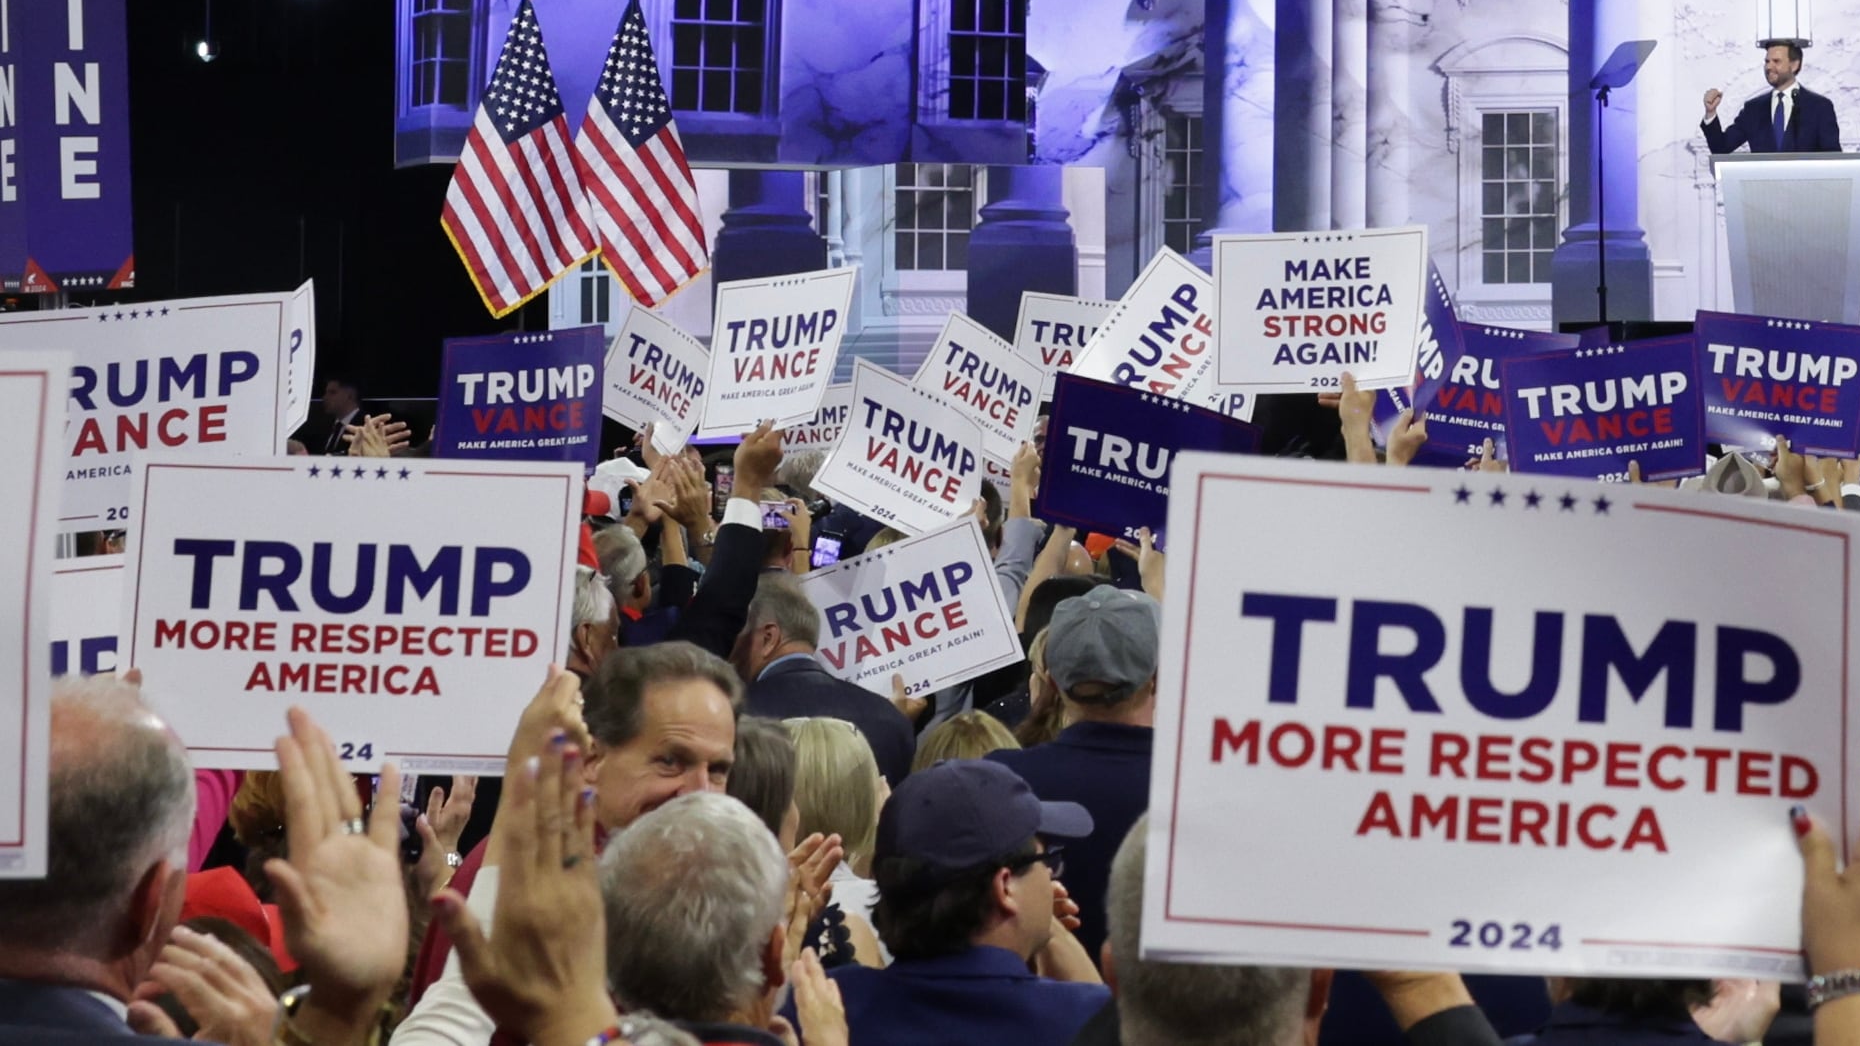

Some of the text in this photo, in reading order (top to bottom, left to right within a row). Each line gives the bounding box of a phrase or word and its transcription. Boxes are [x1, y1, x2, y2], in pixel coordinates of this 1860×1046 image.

[1285, 257, 1370, 282] MAKE
[1256, 284, 1392, 310] AMERICA
[727, 309, 837, 353] TRUMP
[1031, 320, 1098, 347] TRU
[1112, 283, 1198, 388] RUMP
[1263, 312, 1386, 338] STRONG
[628, 332, 704, 400] TRUMP
[734, 348, 820, 383] VANCE
[1148, 314, 1212, 395] ANCE
[1272, 340, 1378, 365] AGAIN!
[1708, 343, 1857, 386] TRUMP
[70, 351, 260, 410] RUMP
[457, 364, 595, 405] TRUMP
[628, 362, 690, 420] VANCE
[945, 341, 1032, 408] TRUMP
[1178, 377, 1199, 402] ERICA
[1311, 377, 1340, 387] 202
[721, 391, 740, 401] MAKE
[741, 389, 776, 399] AMERICA
[943, 371, 1019, 429] VANCE
[1437, 386, 1503, 416] VAN
[1517, 371, 1687, 419] TRUMP
[1721, 378, 1840, 413] VANCE
[66, 405, 227, 457] ANCE
[472, 402, 584, 434] VANCE
[1449, 416, 1489, 429] AMERICA
[1540, 407, 1673, 446] VANCE
[1708, 405, 1843, 428] MAKE AMERICA GREAT AGAIN!
[458, 440, 487, 450] MAKE
[489, 438, 535, 448] AMERICA
[537, 436, 566, 447] GREAT
[863, 396, 976, 476] TRUMP
[1467, 444, 1495, 454] 20
[1534, 438, 1684, 462] MAKE AMERICA GREAT AGAIN!
[1760, 436, 1791, 449] 20
[66, 465, 132, 480] AMERICA
[866, 436, 962, 504] VANCE
[1067, 426, 1169, 499] TRU
[1071, 464, 1101, 478] MAKE
[1105, 472, 1152, 491] AMERICA
[1598, 473, 1630, 484] 2024
[847, 462, 870, 478] MAKE
[869, 474, 902, 493] AMERICA
[902, 490, 927, 506] GREAT
[106, 506, 128, 521] 20
[871, 505, 896, 522] 2024
[1124, 526, 1157, 544] 20
[173, 538, 532, 617] TRUMP
[824, 561, 973, 639] RUMP
[154, 619, 539, 659] MORE RESPECTED
[820, 600, 969, 671] VANCE
[856, 629, 985, 682] AMERICA GREAT AGAIN!
[1240, 590, 1801, 733] TRUMP
[244, 662, 440, 695] AMERICA
[904, 679, 930, 696] 024
[340, 743, 373, 760] 24
[1210, 718, 1819, 800] MORE RESPECTED
[1355, 791, 1668, 853] AMERICA
[1448, 920, 1563, 952] 2024
